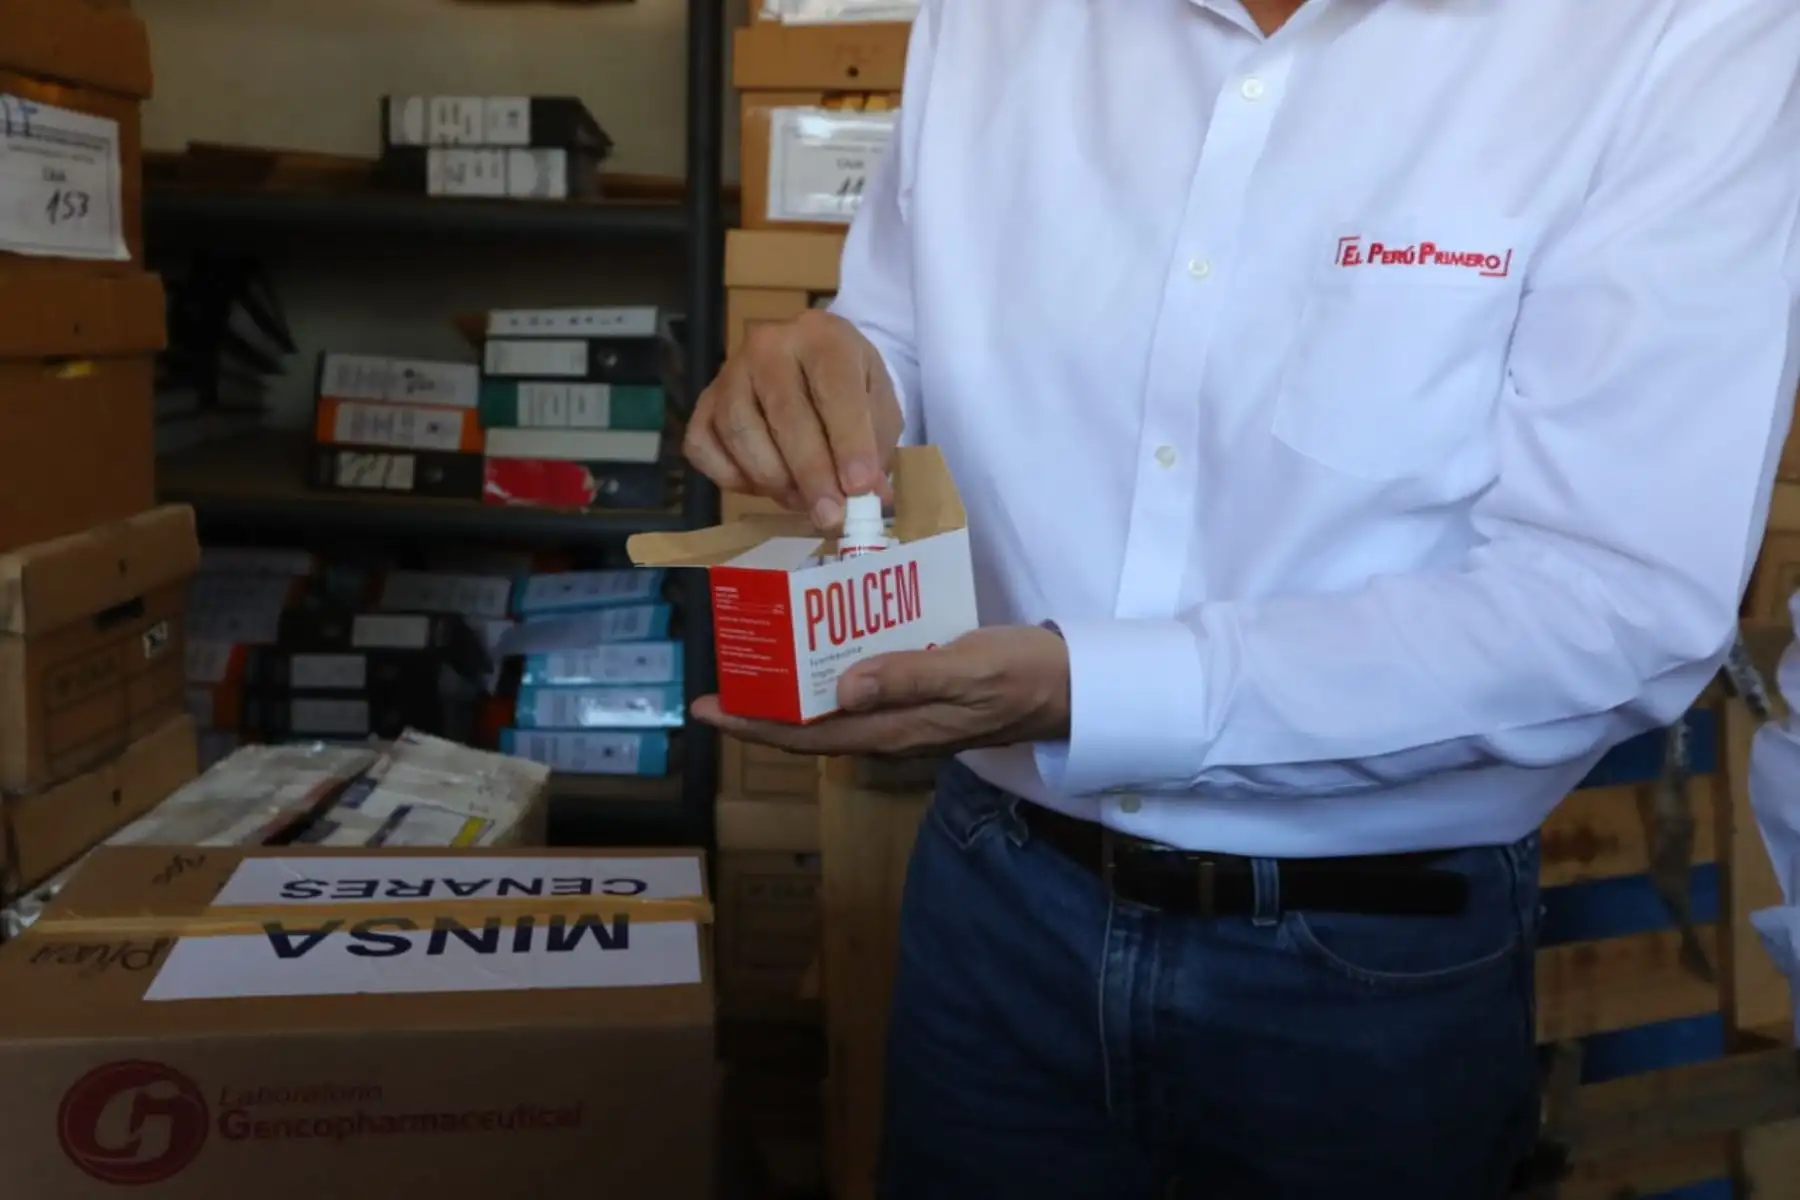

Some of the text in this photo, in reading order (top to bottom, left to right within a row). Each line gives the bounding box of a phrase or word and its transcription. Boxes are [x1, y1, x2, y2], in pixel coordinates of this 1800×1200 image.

[46, 189, 90, 225] 153
[1418, 241, 1501, 269] PRIMERO
[804, 560, 922, 652] POLCEM
[279, 876, 648, 899] CENARES
[263, 914, 630, 959] MINSA
